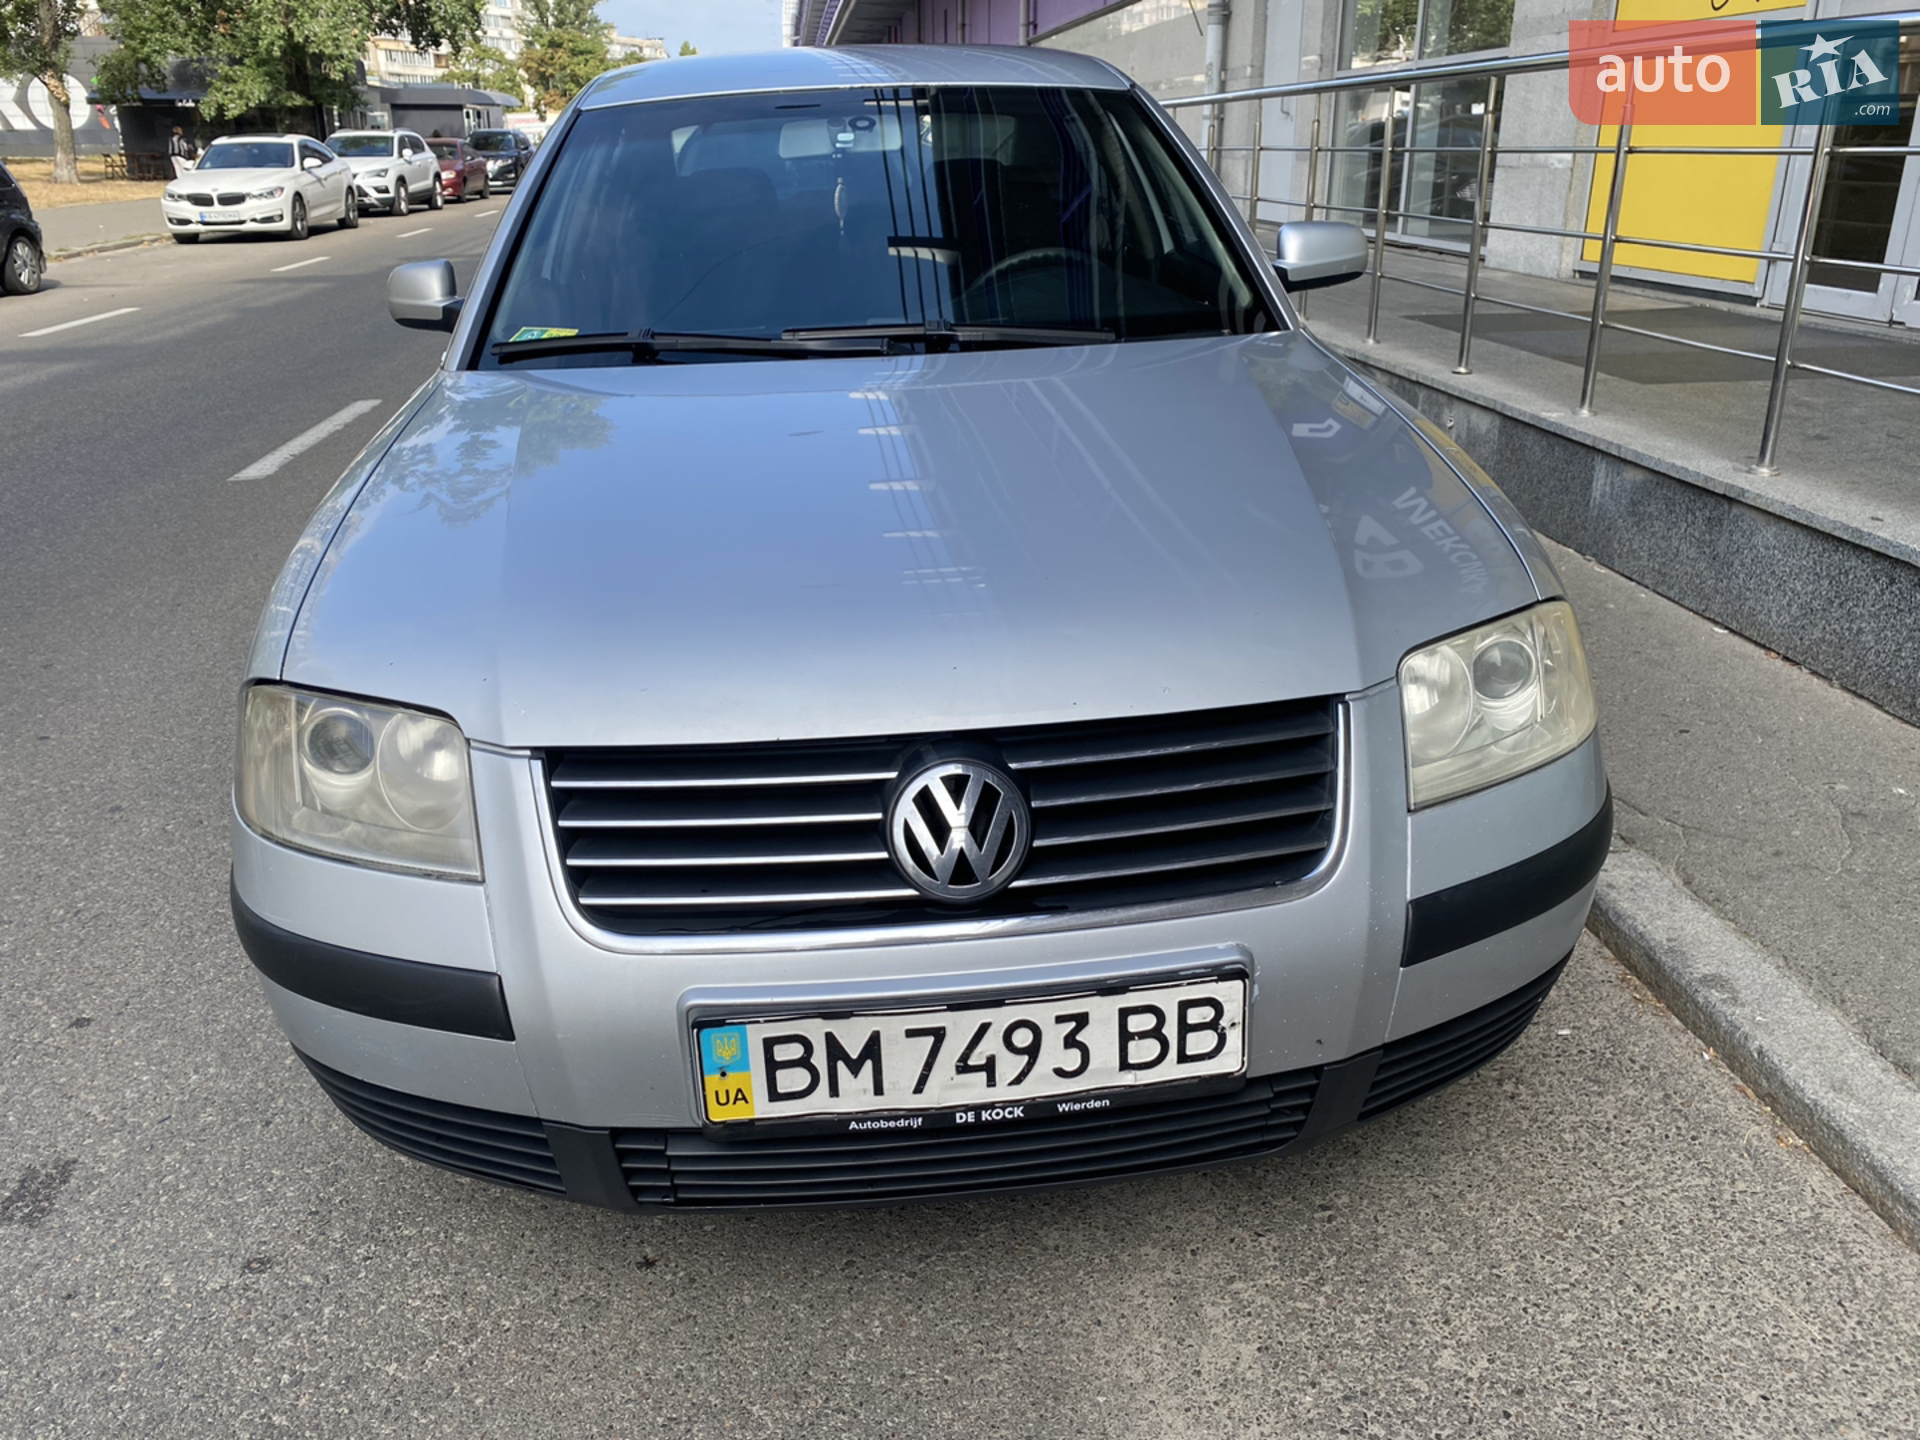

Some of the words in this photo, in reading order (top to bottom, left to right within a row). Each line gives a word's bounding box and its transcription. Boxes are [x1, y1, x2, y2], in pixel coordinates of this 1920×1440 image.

[762, 1029, 885, 1103] BM
[904, 1010, 1091, 1096] 7493
[1117, 996, 1228, 1072] BB
[714, 1087, 750, 1107] UA
[848, 1116, 923, 1131] Autobedrijf
[955, 1111, 975, 1124] DE
[980, 1105, 1025, 1121] KOCK
[1056, 1098, 1110, 1113] Wierden
